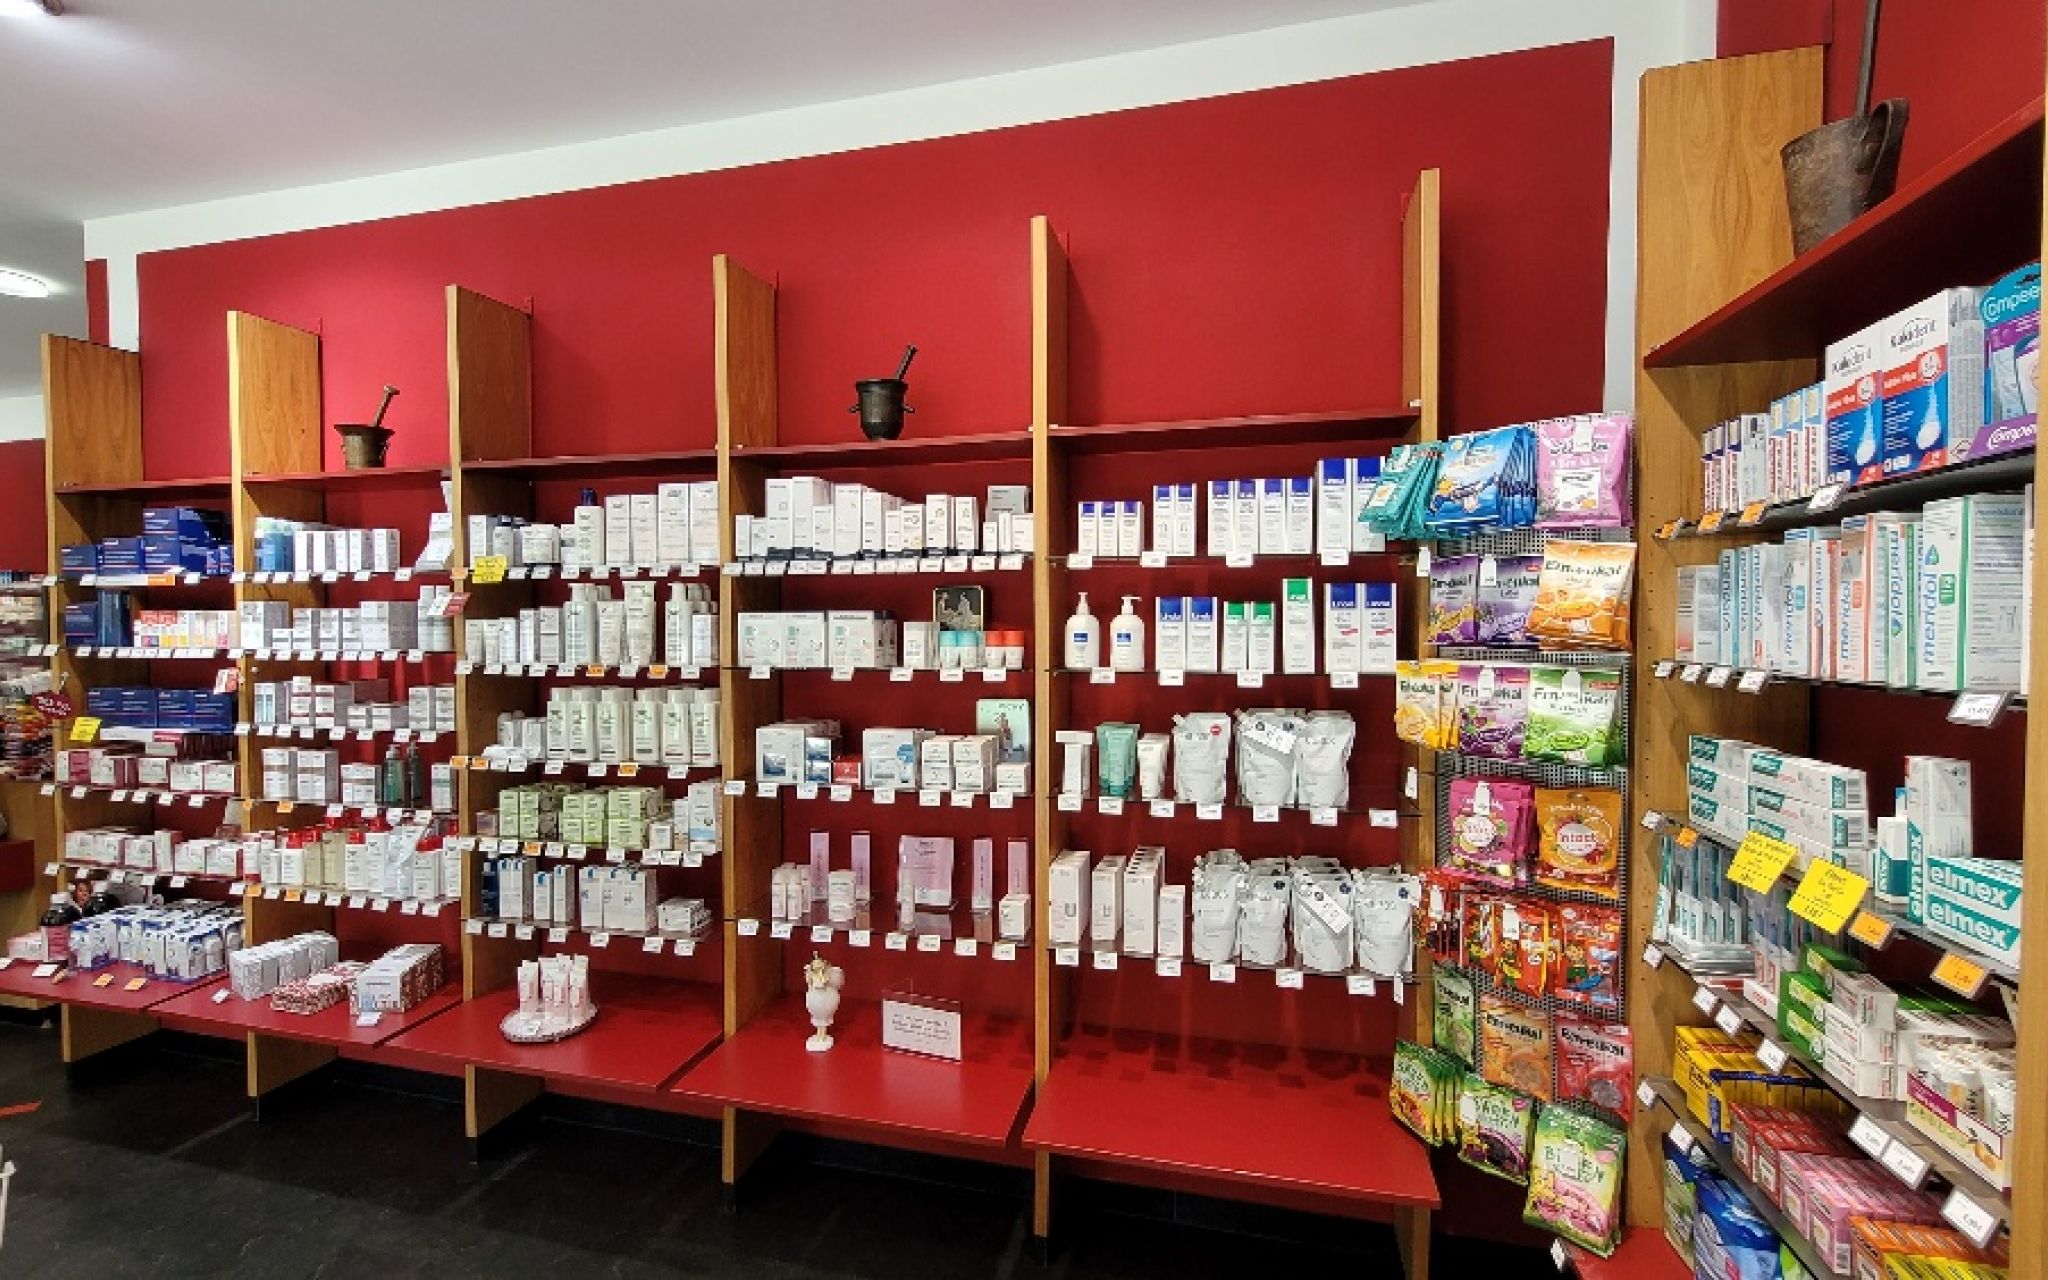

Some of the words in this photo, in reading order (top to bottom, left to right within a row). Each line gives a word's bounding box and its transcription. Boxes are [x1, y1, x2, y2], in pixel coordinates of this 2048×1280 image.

[1983, 285, 2041, 323] Compee
[1910, 833, 1923, 918] elmex
[1930, 864, 2009, 909] elmex
[1930, 901, 2009, 951] elmex
